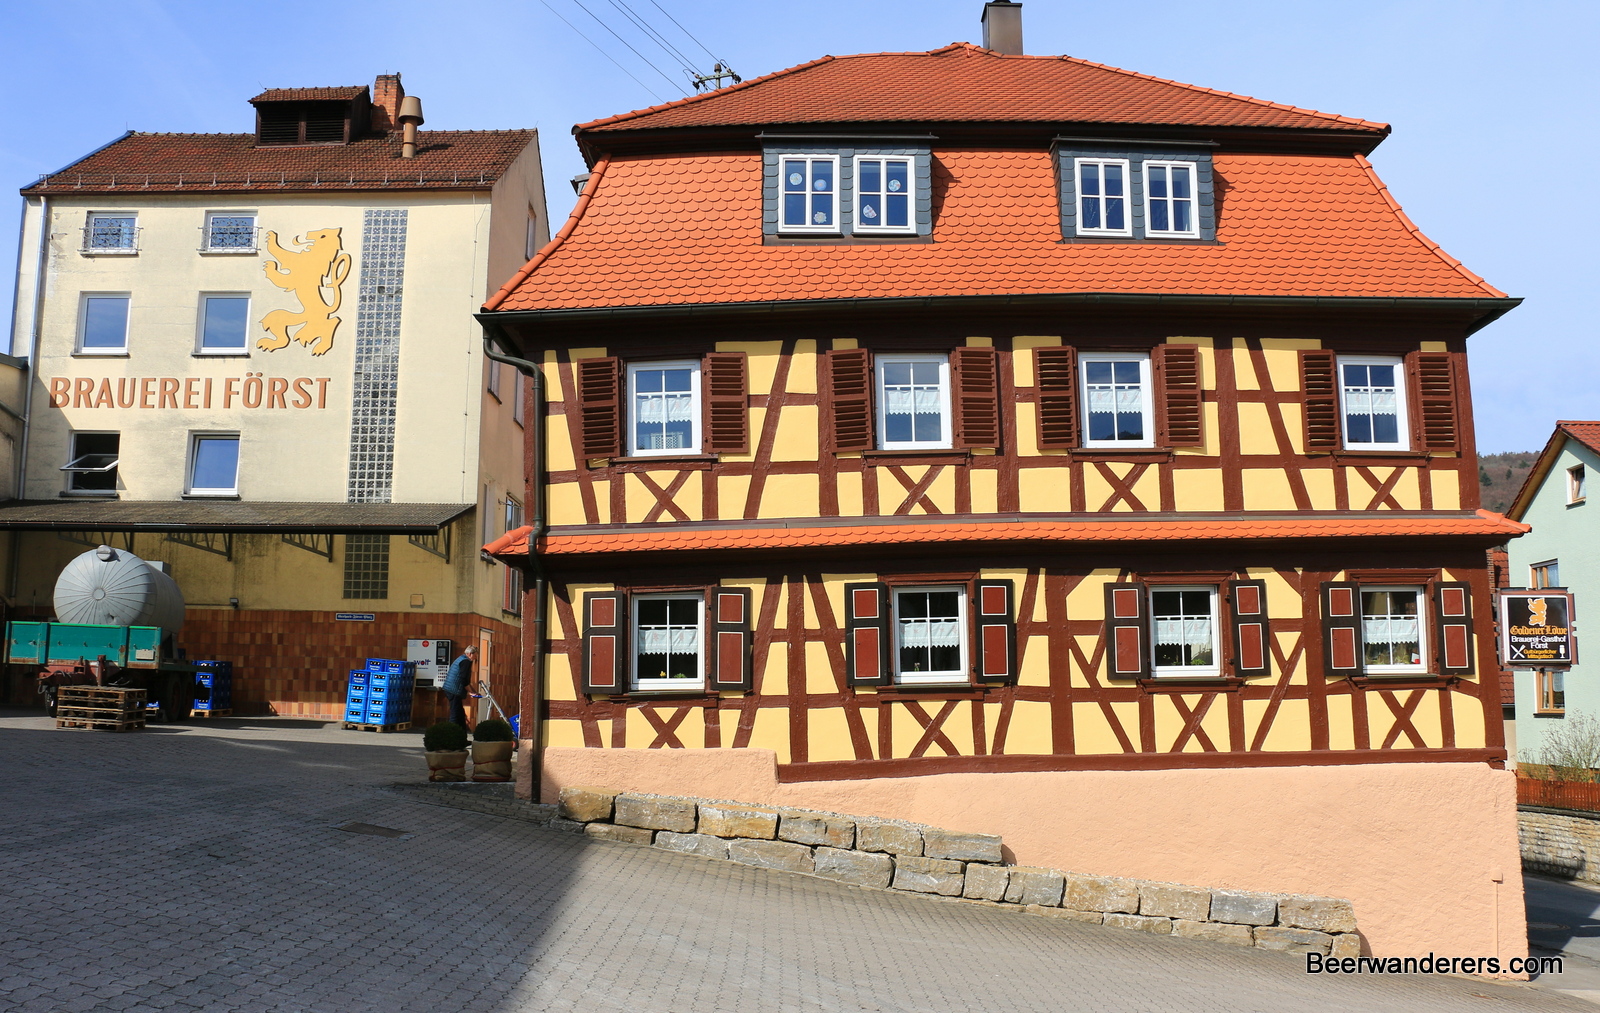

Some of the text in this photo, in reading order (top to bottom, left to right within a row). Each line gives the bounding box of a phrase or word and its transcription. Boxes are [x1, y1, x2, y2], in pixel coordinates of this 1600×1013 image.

[49, 372, 331, 409] BRAUEREI FÖRST
[1510, 625, 1568, 635] Goldener Löwe
